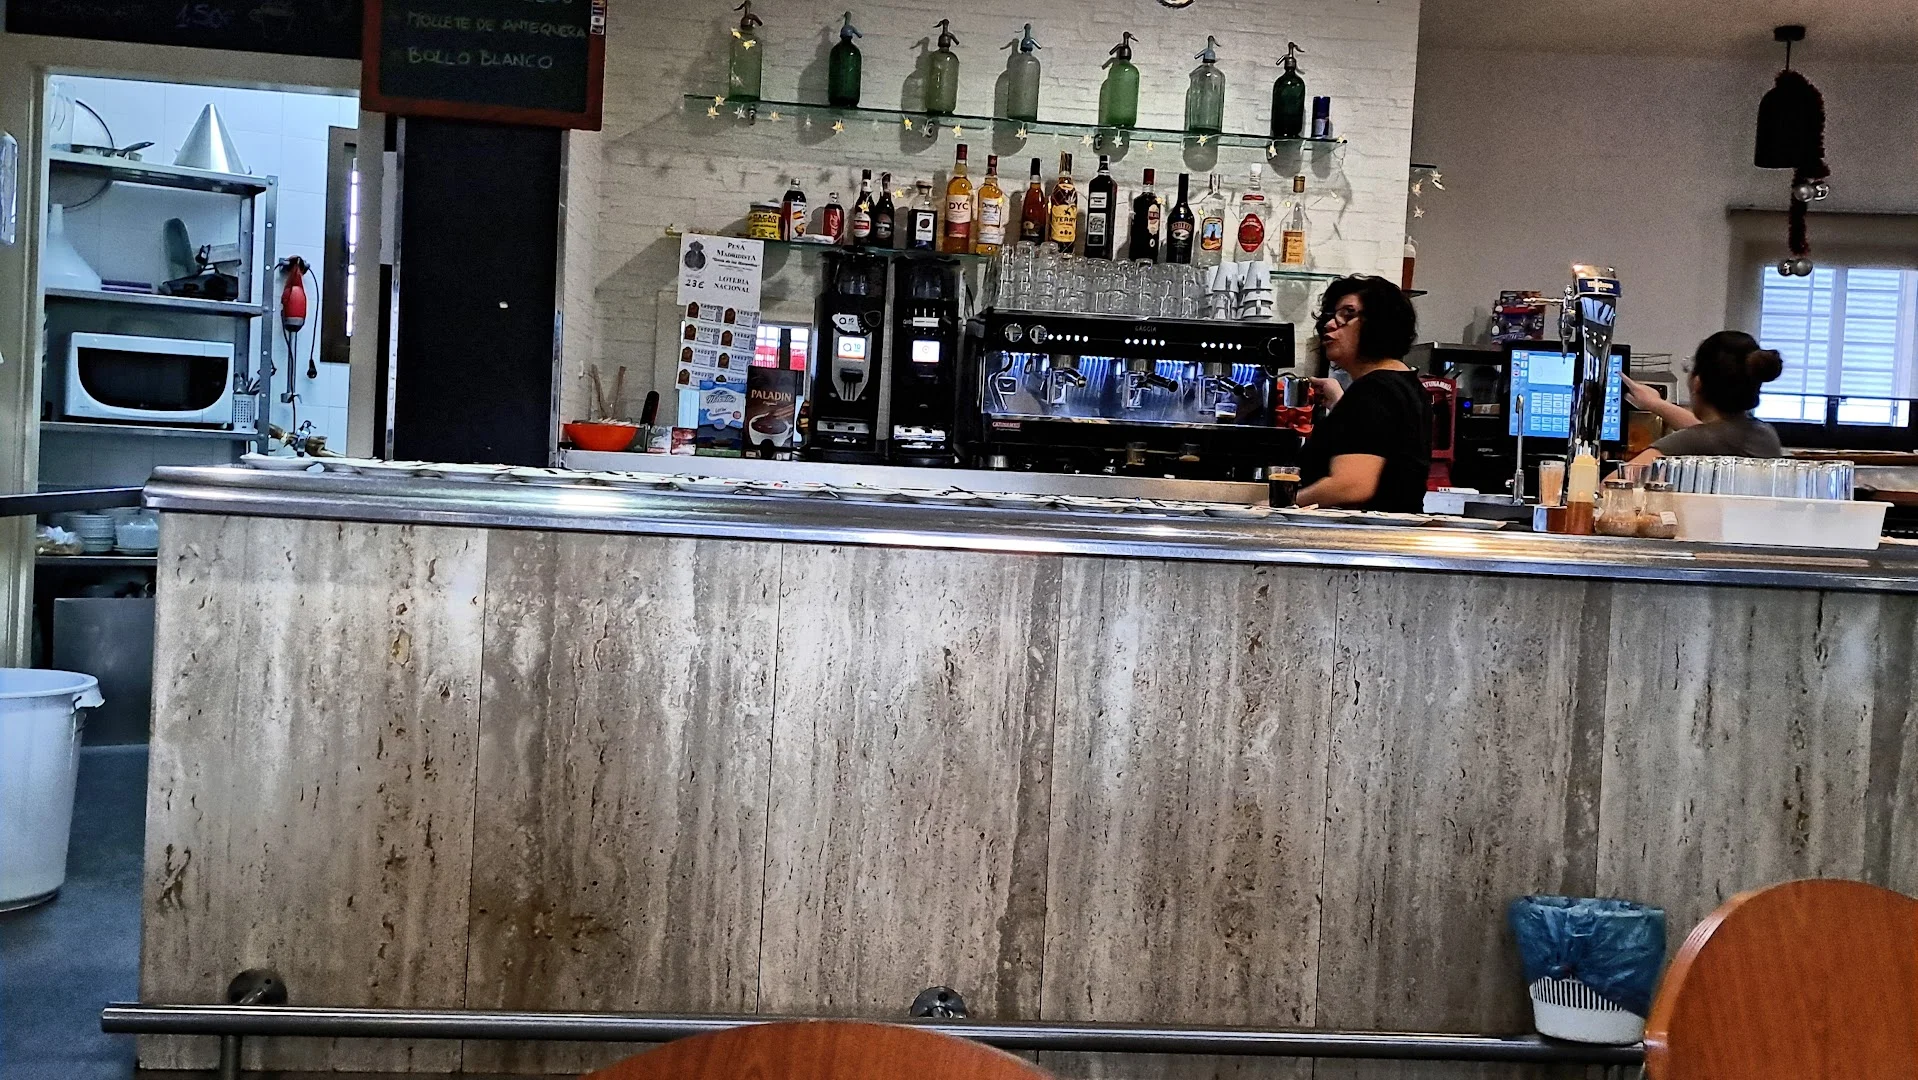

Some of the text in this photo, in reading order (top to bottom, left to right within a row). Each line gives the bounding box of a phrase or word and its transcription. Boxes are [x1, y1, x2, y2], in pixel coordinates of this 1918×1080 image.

[407, 11, 587, 38] MOLLETE DE ANTEQUERA
[408, 47, 553, 69] BOLLO BLANCO
[949, 202, 969, 210] DYC
[685, 279, 705, 289] 23€
[713, 283, 750, 293] NACIONAL
[751, 389, 792, 402] PALADIN
